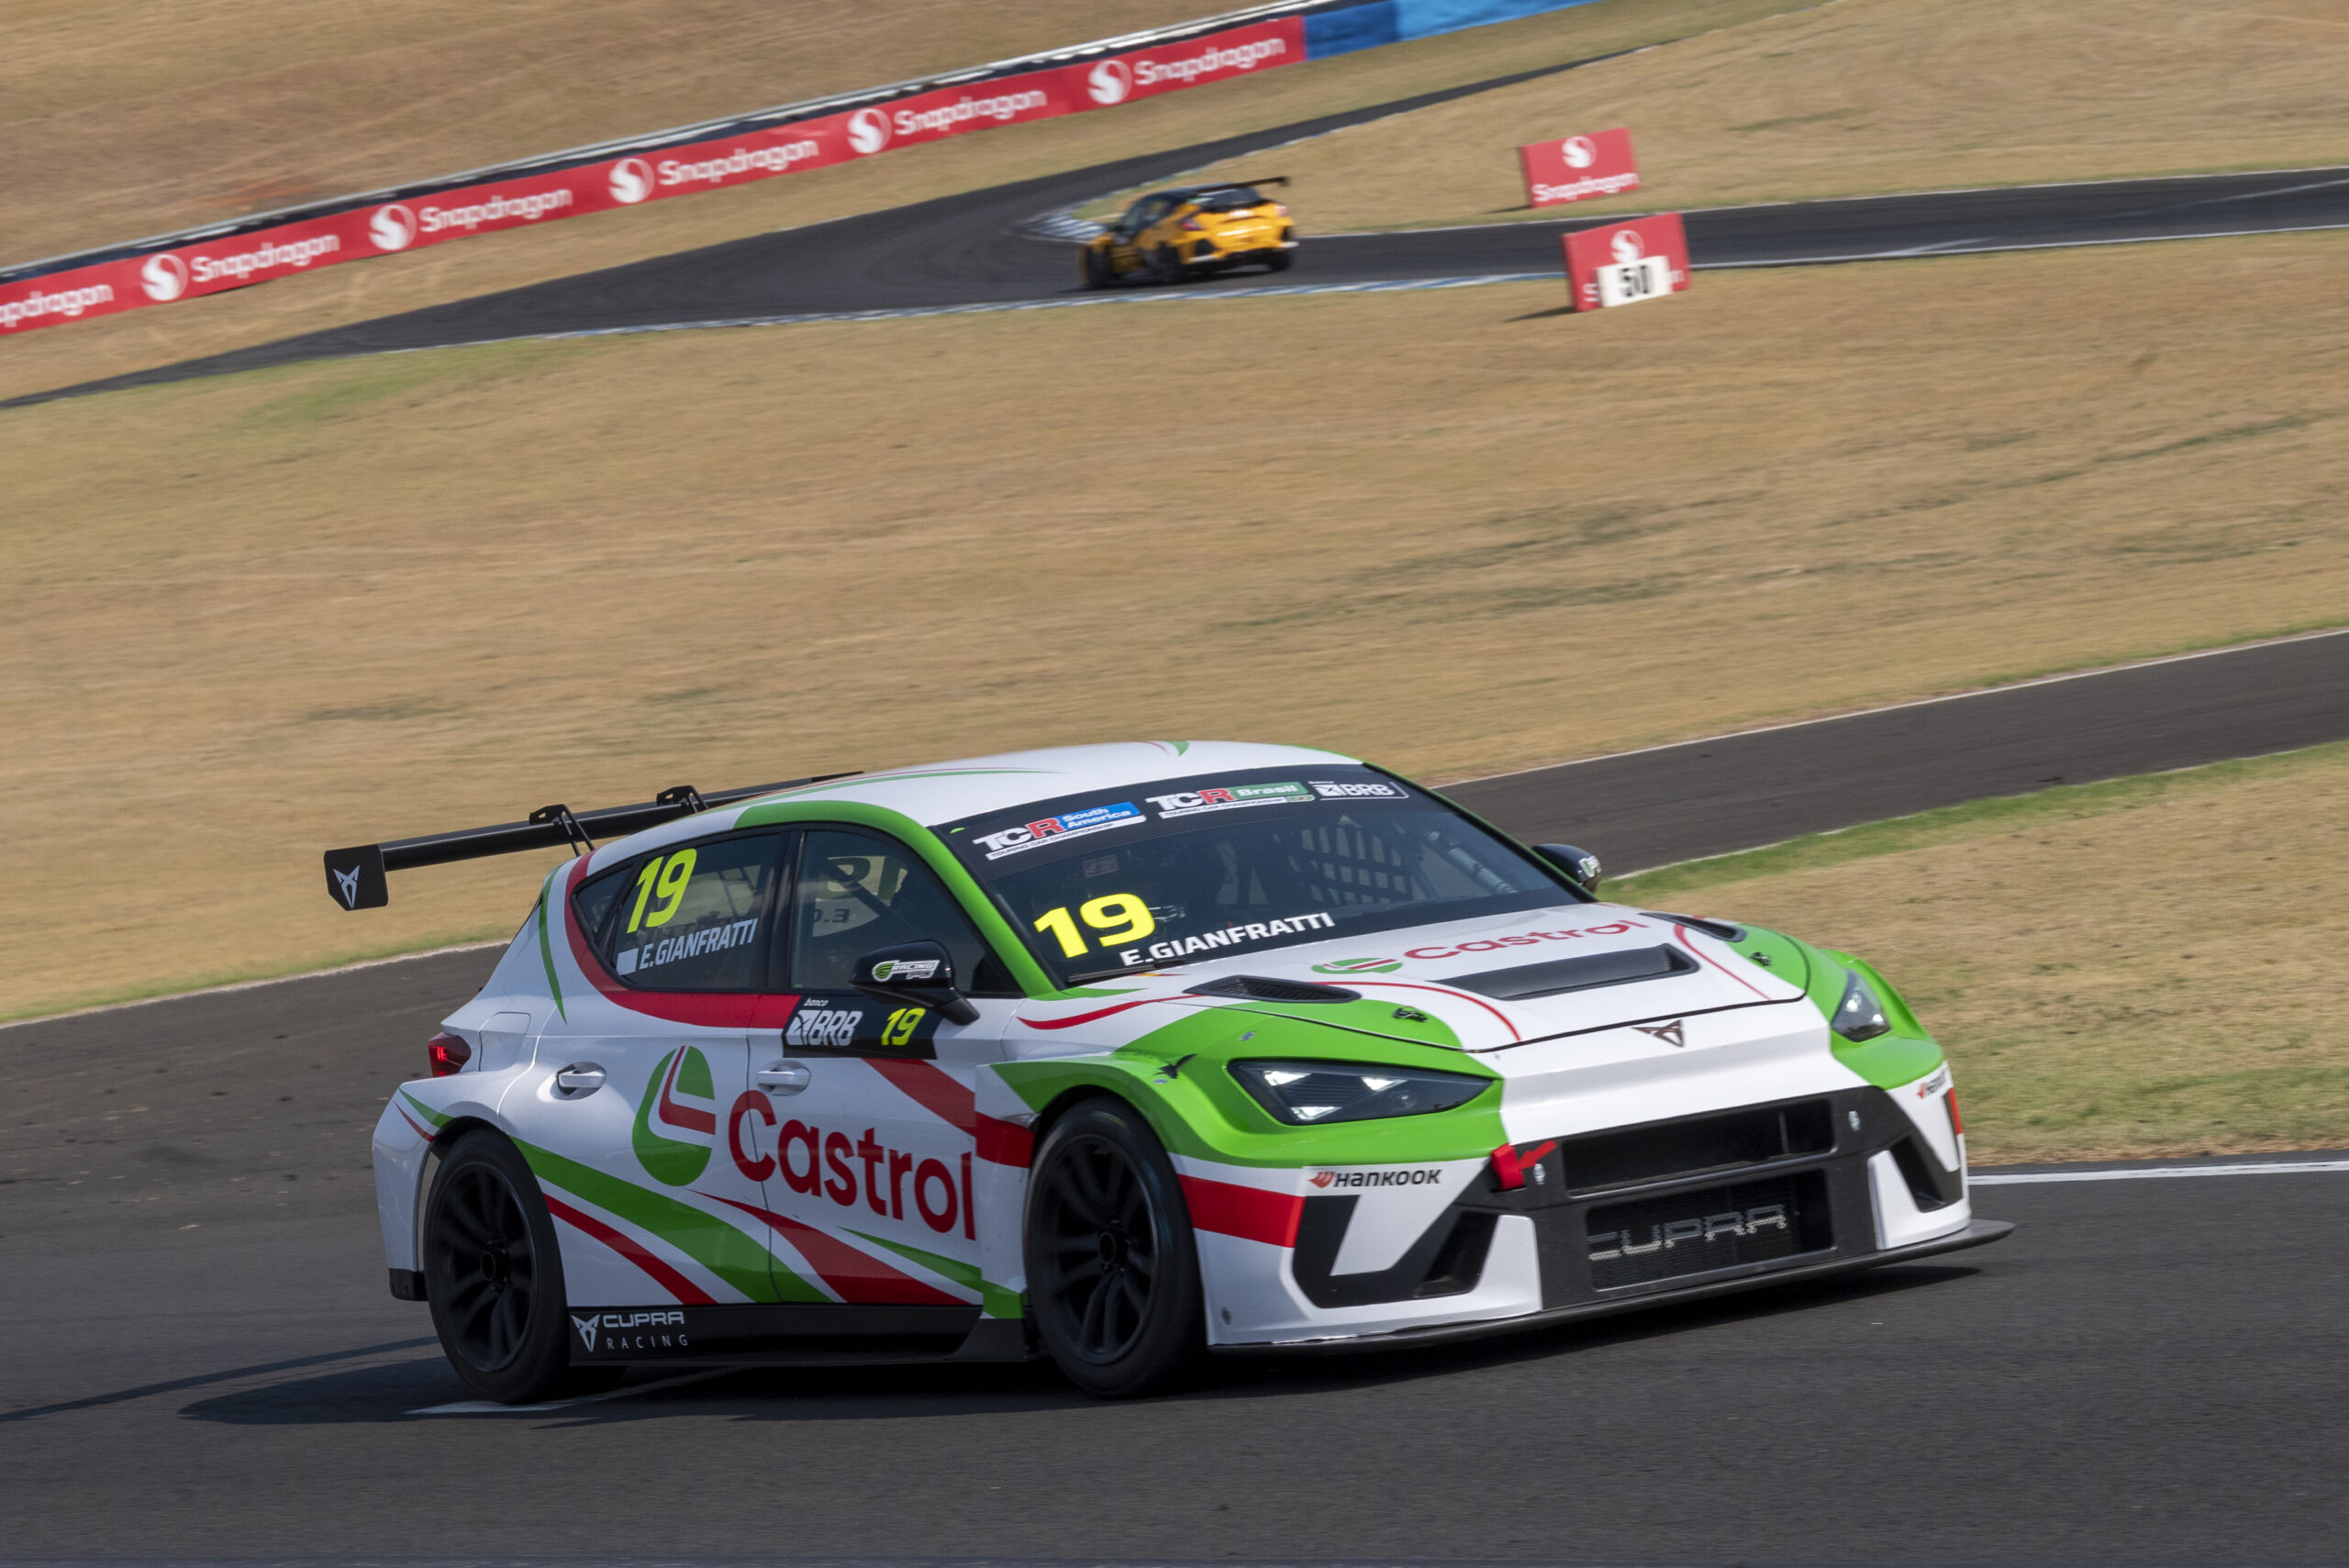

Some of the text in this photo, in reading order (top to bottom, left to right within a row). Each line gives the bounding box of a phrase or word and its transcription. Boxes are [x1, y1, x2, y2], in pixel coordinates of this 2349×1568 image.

[1133, 38, 1286, 84] Snapdragon
[894, 90, 1047, 135] Snapdragon
[657, 140, 819, 185] Snapdragon
[418, 189, 573, 232] Snapdragon
[190, 234, 340, 282] Snapdragon
[1145, 788, 1237, 811] TCR
[1237, 784, 1298, 796] Brasil
[1340, 784, 1395, 795] BRB
[972, 817, 1067, 851] TCR
[1063, 808, 1109, 822] South
[1067, 810, 1132, 828] America
[626, 848, 697, 934] 19
[639, 917, 759, 970] E.GIANFRATTI
[1033, 893, 1156, 958] 19
[1119, 912, 1336, 966] E.GIANFRATTI
[1403, 920, 1652, 960] Castrol
[803, 998, 829, 1006] banco
[807, 1011, 863, 1047] BRB
[881, 1007, 926, 1046] 19
[729, 1089, 977, 1241] Castrol
[603, 1311, 685, 1328] CUPRA
[607, 1334, 688, 1350] RACING
